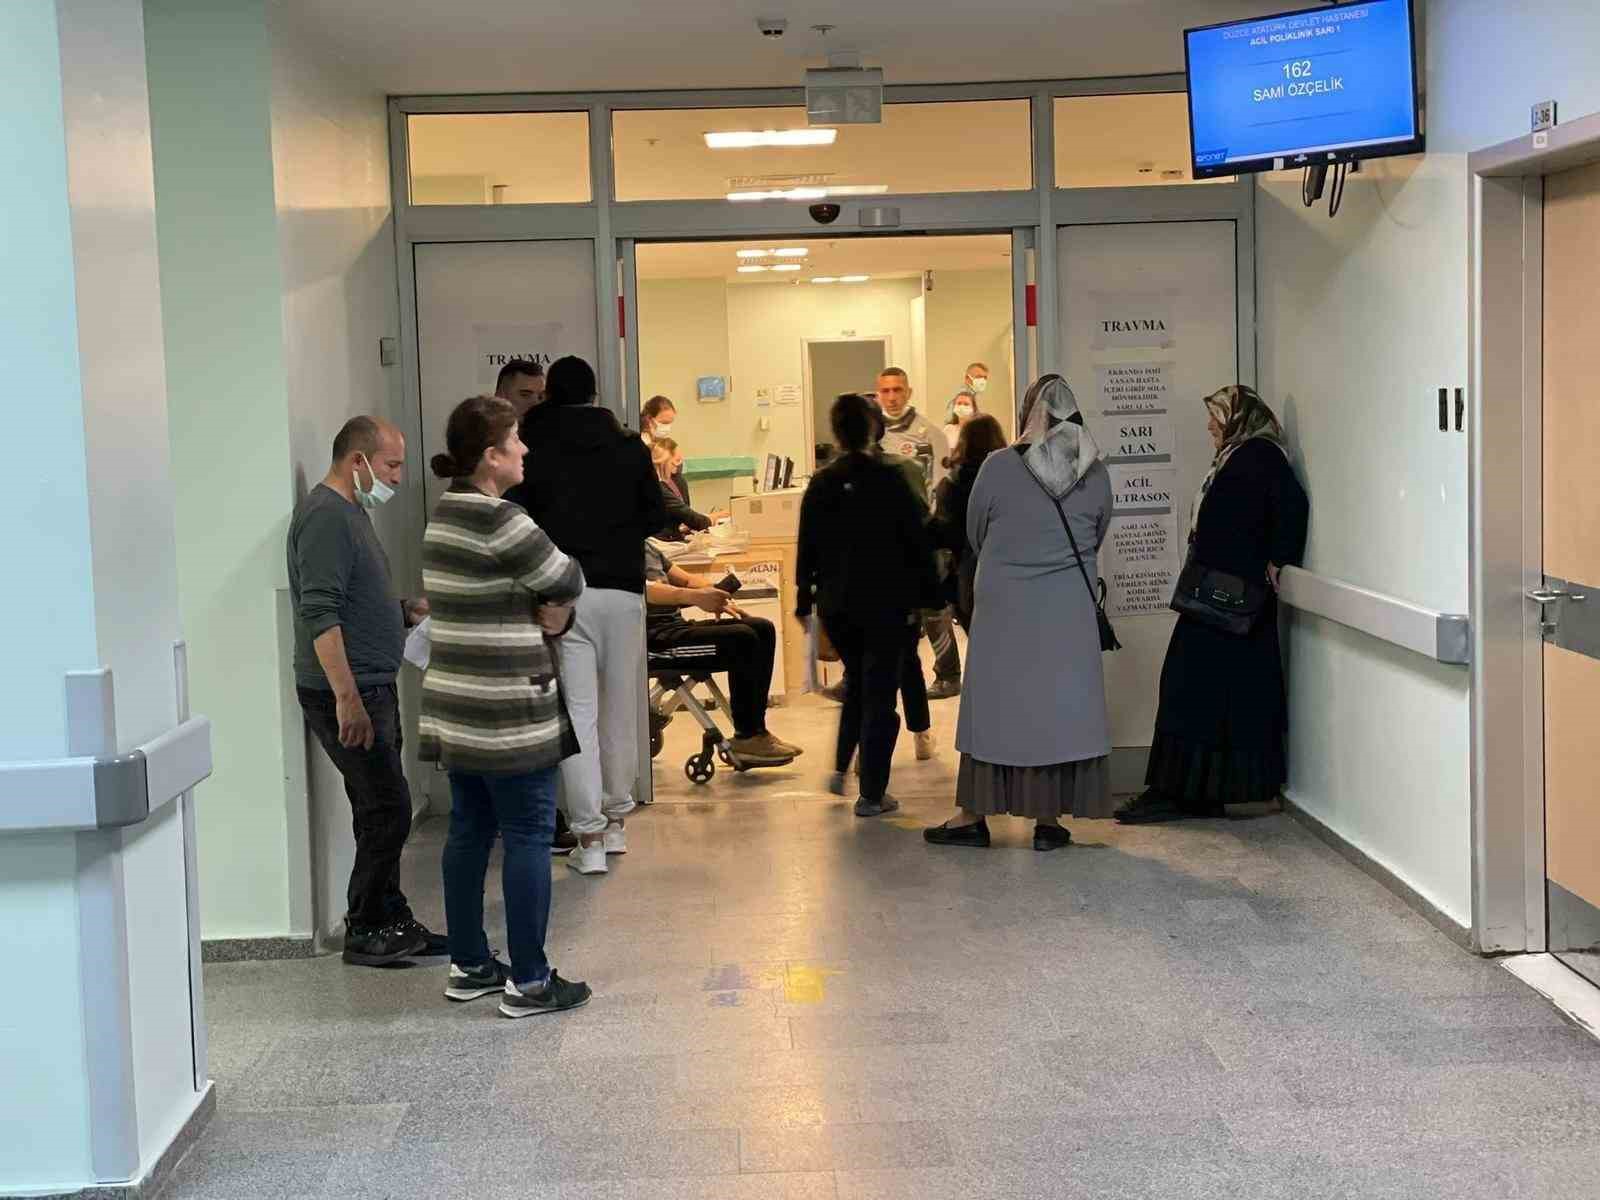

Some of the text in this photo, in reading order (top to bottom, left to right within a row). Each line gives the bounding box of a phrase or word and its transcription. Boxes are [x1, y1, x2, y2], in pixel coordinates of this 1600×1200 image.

[1282, 60, 1312, 79] 162
[1287, 76, 1344, 97] ÖZÇELİK
[1101, 319, 1166, 332] TRAVMA
[1120, 426, 1153, 438] SARI
[1118, 443, 1157, 455] ALAN
[1114, 491, 1171, 504] LTRASON
